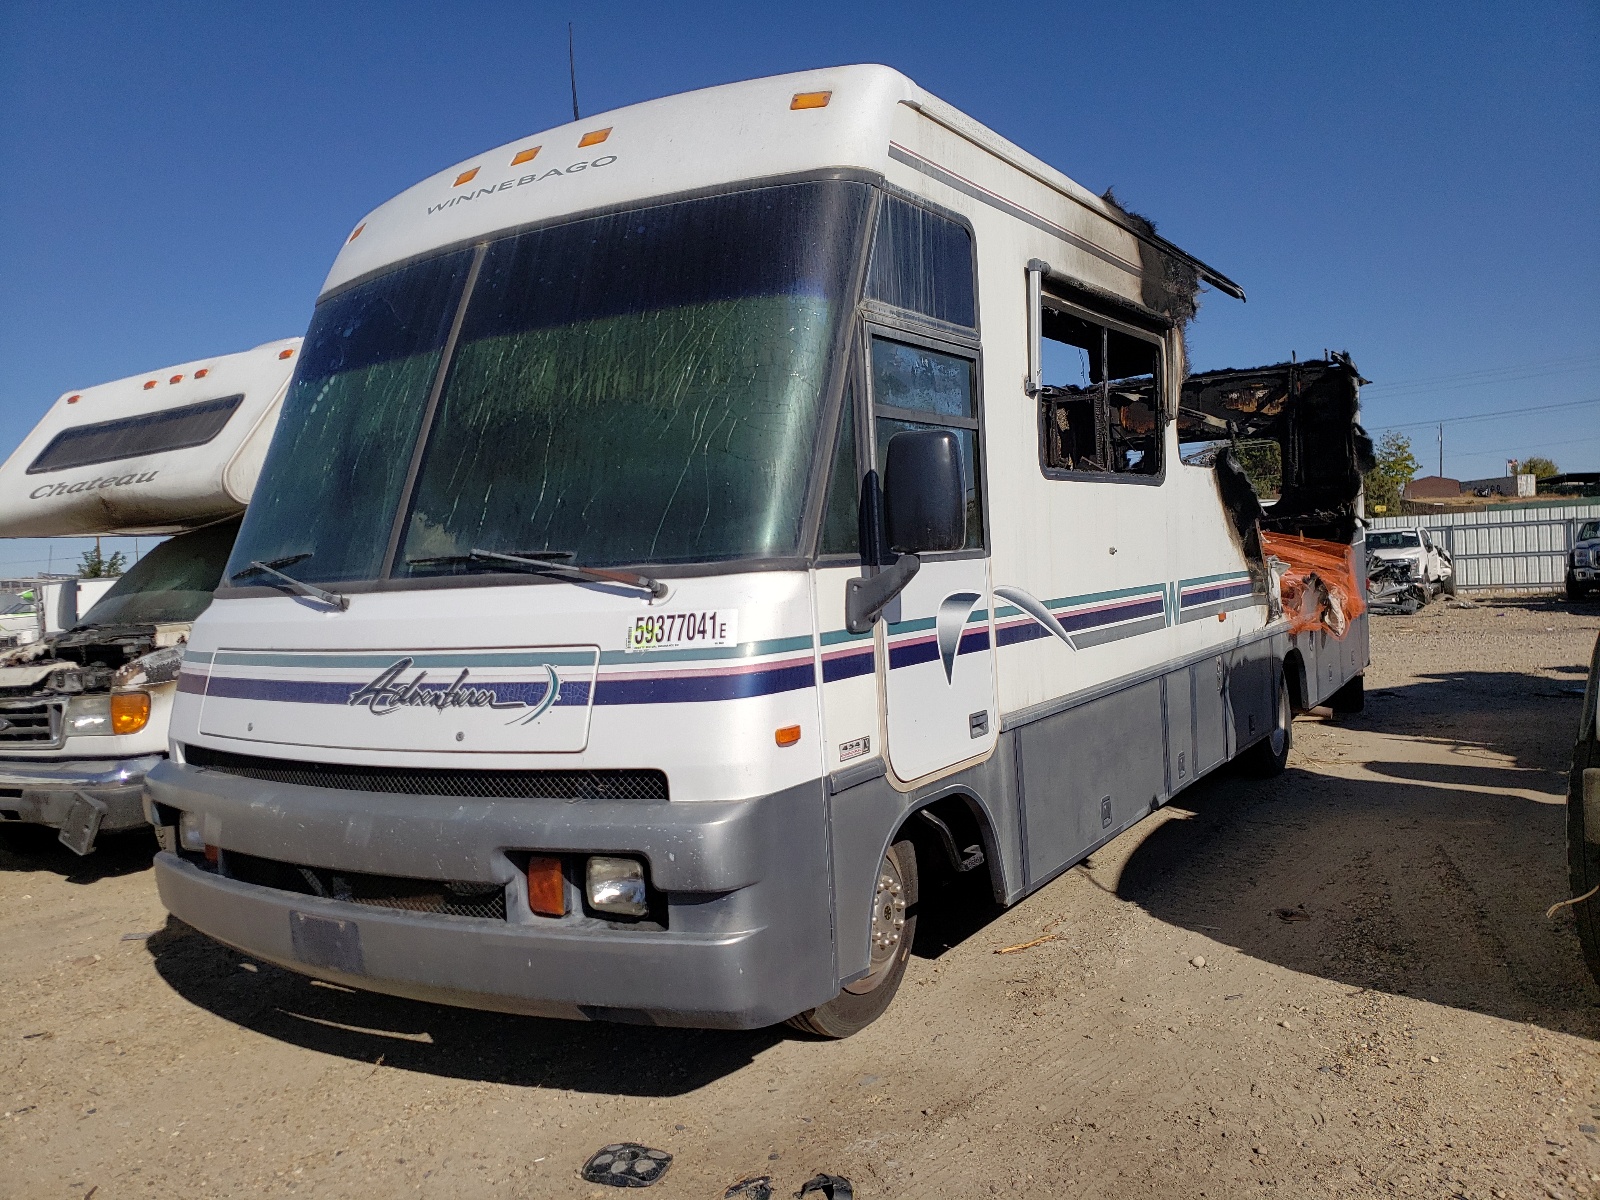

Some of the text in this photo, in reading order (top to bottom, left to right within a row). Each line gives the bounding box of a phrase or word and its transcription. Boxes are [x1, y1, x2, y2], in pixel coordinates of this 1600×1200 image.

[427, 155, 618, 215] WINNEBAGO
[29, 470, 160, 500] Chateau
[634, 611, 727, 645] 59377041 E
[349, 657, 526, 716] Adventurer
[842, 741, 861, 751] 454
